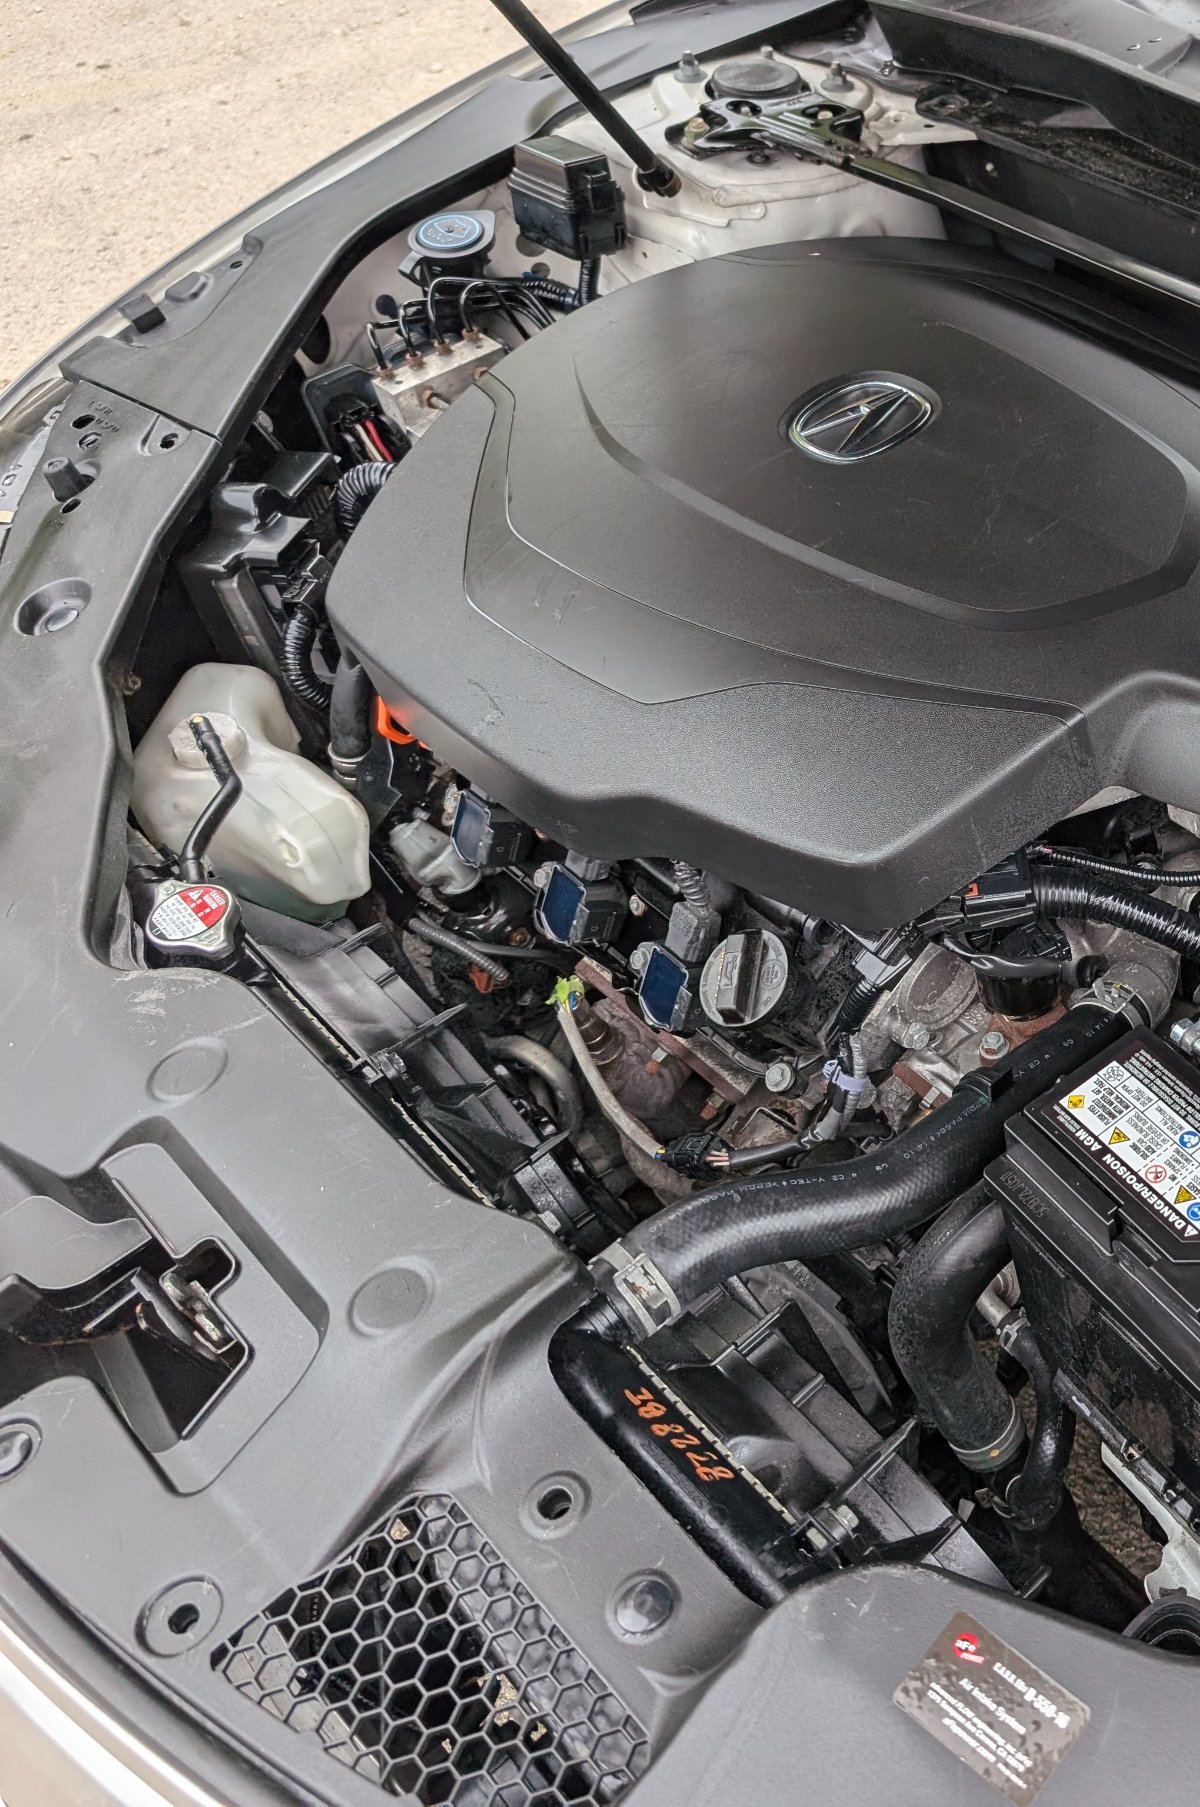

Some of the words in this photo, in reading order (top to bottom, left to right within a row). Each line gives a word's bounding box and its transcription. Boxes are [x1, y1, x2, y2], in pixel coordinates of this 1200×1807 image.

[1091, 1087, 1102, 1096] GET
[1102, 1086, 1115, 1097] HELP
[1121, 1084, 1134, 1095] OPEN
[1112, 1095, 1131, 1111] MEDICAL
[1131, 1093, 1141, 1102] NOT
[1088, 1104, 1100, 1115] EYES
[1112, 1105, 1124, 1115] WITH
[1139, 1100, 1148, 1108] DO
[1097, 1113, 1111, 1125] FLUSH
[1159, 1118, 1169, 1126] ALL
[1126, 1117, 1150, 1138] BLINDNESS
[1147, 1124, 1164, 1139] SEVERE
[1166, 1124, 1180, 1136] READ
[1074, 1128, 1102, 1153] AGM
[1136, 1137, 1147, 1147] CAN
[1147, 1136, 1163, 1150] CAUSE
[1161, 1137, 1170, 1145] OR
[1129, 1142, 1150, 1160] SULFURIC
[1144, 1145, 1156, 1155] ACID
[1173, 1147, 1193, 1165] SMOKING
[1164, 1159, 1181, 1174] SPARKS
[1170, 1154, 1187, 1169] FLAMES
[1168, 1173, 1178, 1182] NO
[1102, 1153, 1186, 1229] DANGER/POISON
[1186, 1182, 1200, 1195] GASES
[959, 1678, 974, 1691] Air
[971, 1686, 997, 1710] Intake
[994, 1705, 1027, 1735] System
